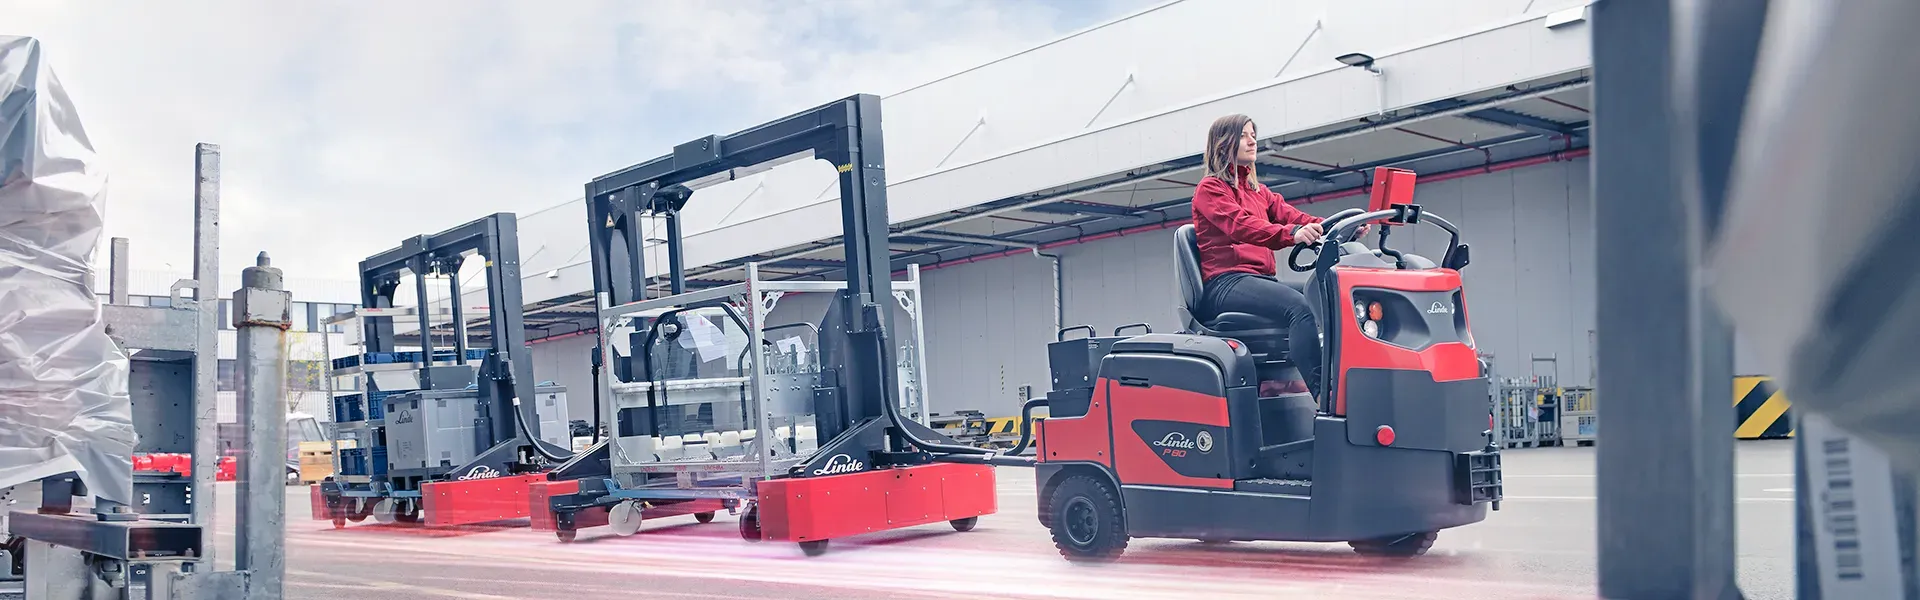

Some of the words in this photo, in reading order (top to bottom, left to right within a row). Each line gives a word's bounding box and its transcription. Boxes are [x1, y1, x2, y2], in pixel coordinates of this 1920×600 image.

[1427, 301, 1448, 314] Linde
[1153, 432, 1195, 449] Linde
[813, 453, 863, 475] Linde
[457, 465, 500, 480] Linde
